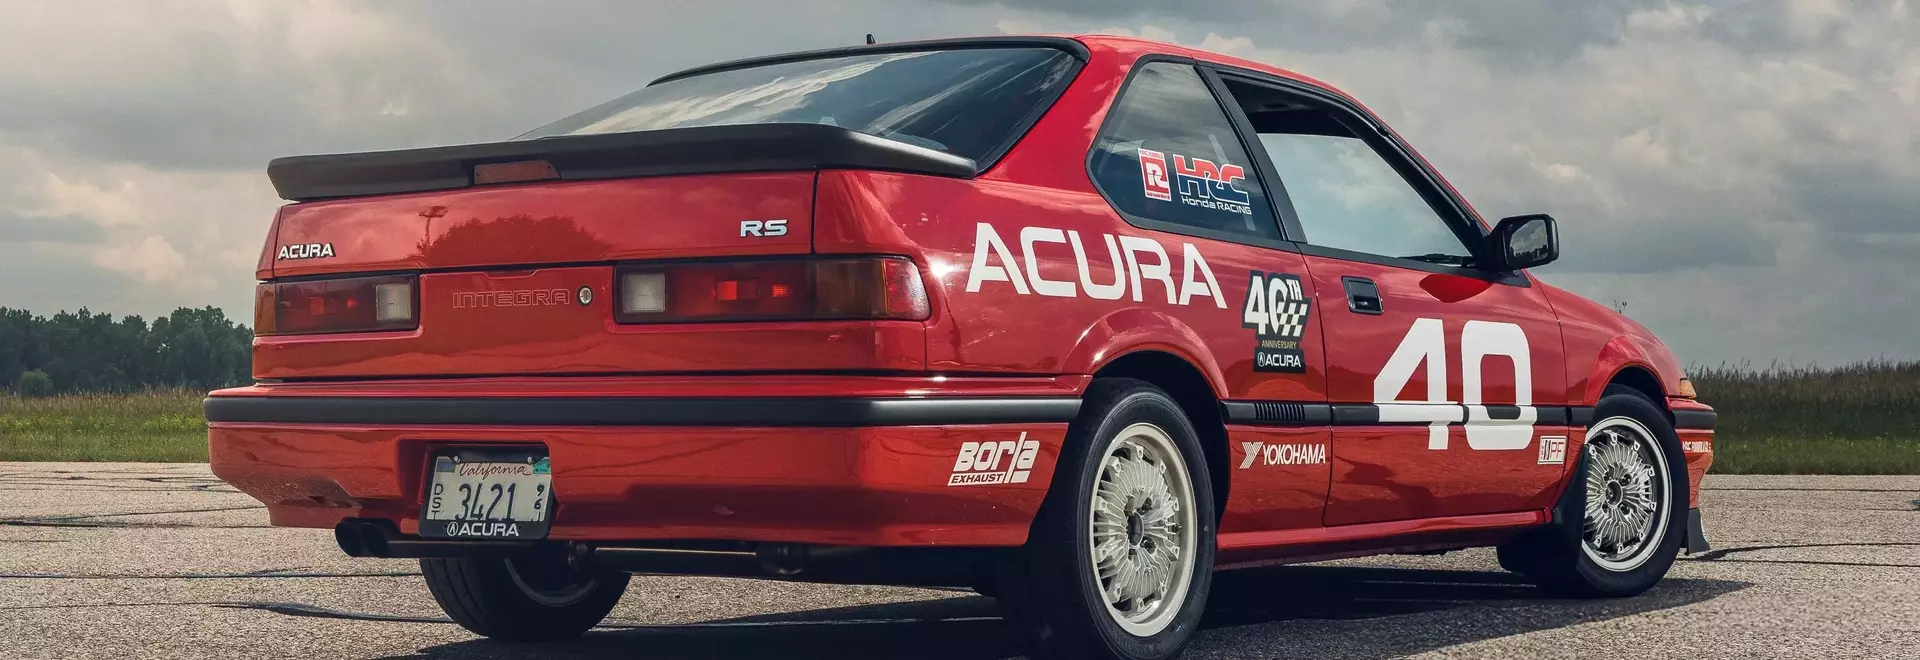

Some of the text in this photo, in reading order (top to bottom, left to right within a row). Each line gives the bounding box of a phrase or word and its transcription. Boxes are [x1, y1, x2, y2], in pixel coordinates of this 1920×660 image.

[1173, 154, 1250, 206] HRC
[1181, 196, 1217, 210] Honda
[1216, 202, 1252, 215] RACING
[740, 219, 788, 237] RS
[278, 242, 336, 260] ACURA
[965, 222, 1228, 309] ACURA
[452, 288, 571, 309] INTEGRA
[1261, 340, 1298, 350] ANNIVERSARY
[1265, 354, 1302, 367] ACURA
[1373, 317, 1538, 450] 40
[1262, 443, 1326, 465] YOKOHAMA
[459, 462, 532, 480] California
[951, 473, 1004, 484] EXHAUST
[454, 483, 517, 521] 3421
[457, 522, 519, 537] ACURA
